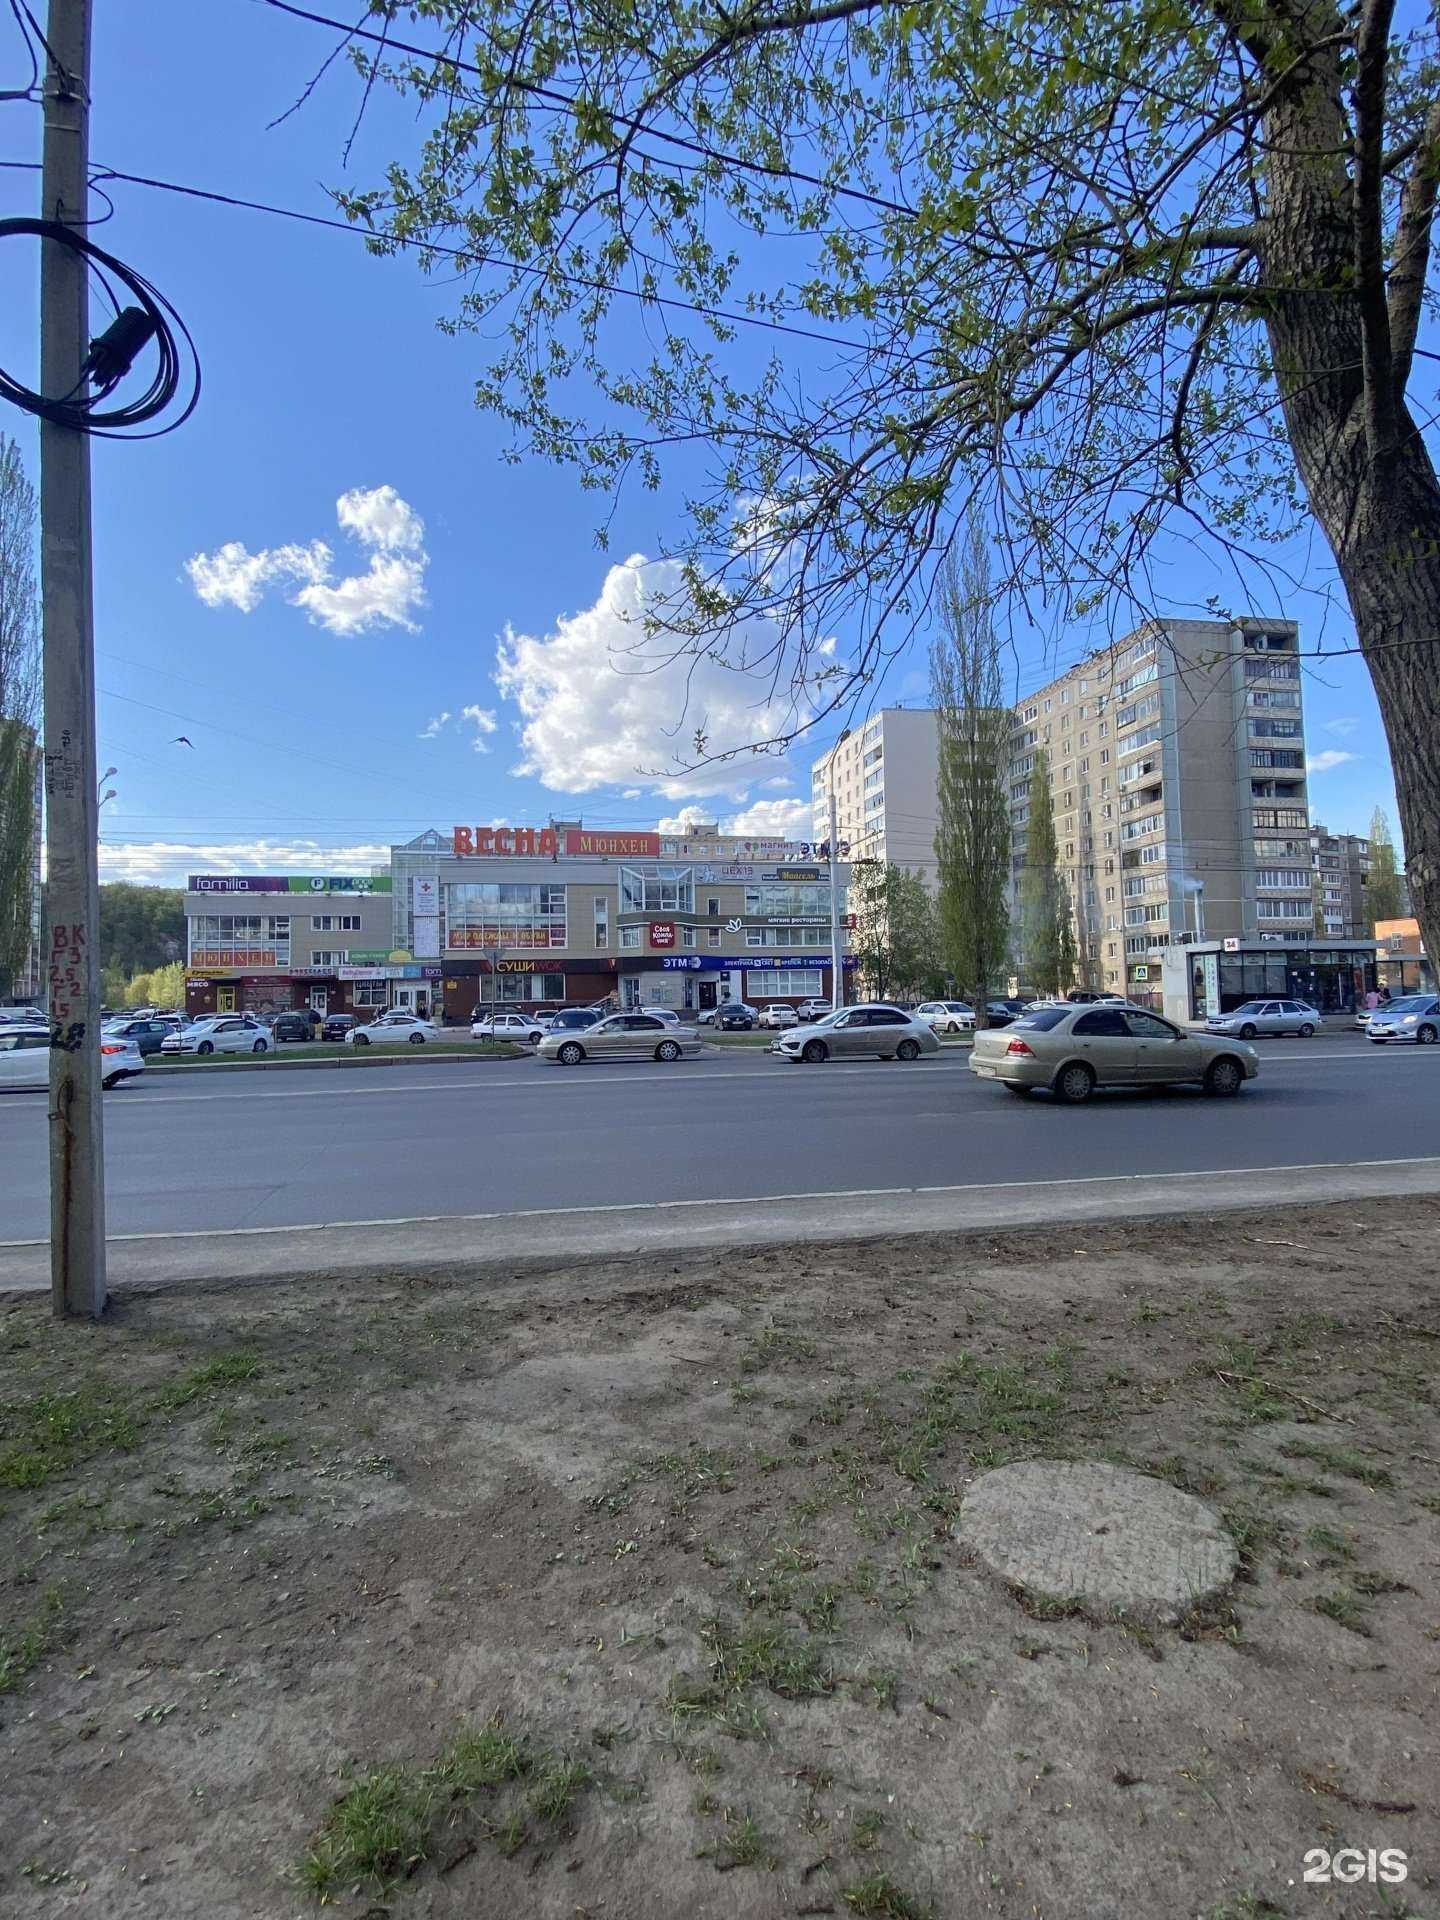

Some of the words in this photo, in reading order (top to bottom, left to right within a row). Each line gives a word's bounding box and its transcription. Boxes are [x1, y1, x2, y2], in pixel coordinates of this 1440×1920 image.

[453, 826, 557, 856] ВЕСНА
[579, 836, 649, 853] МЮНХЕН
[196, 877, 249, 890] familia
[496, 960, 536, 972] СУШИ
[663, 958, 688, 968] ЭТМ
